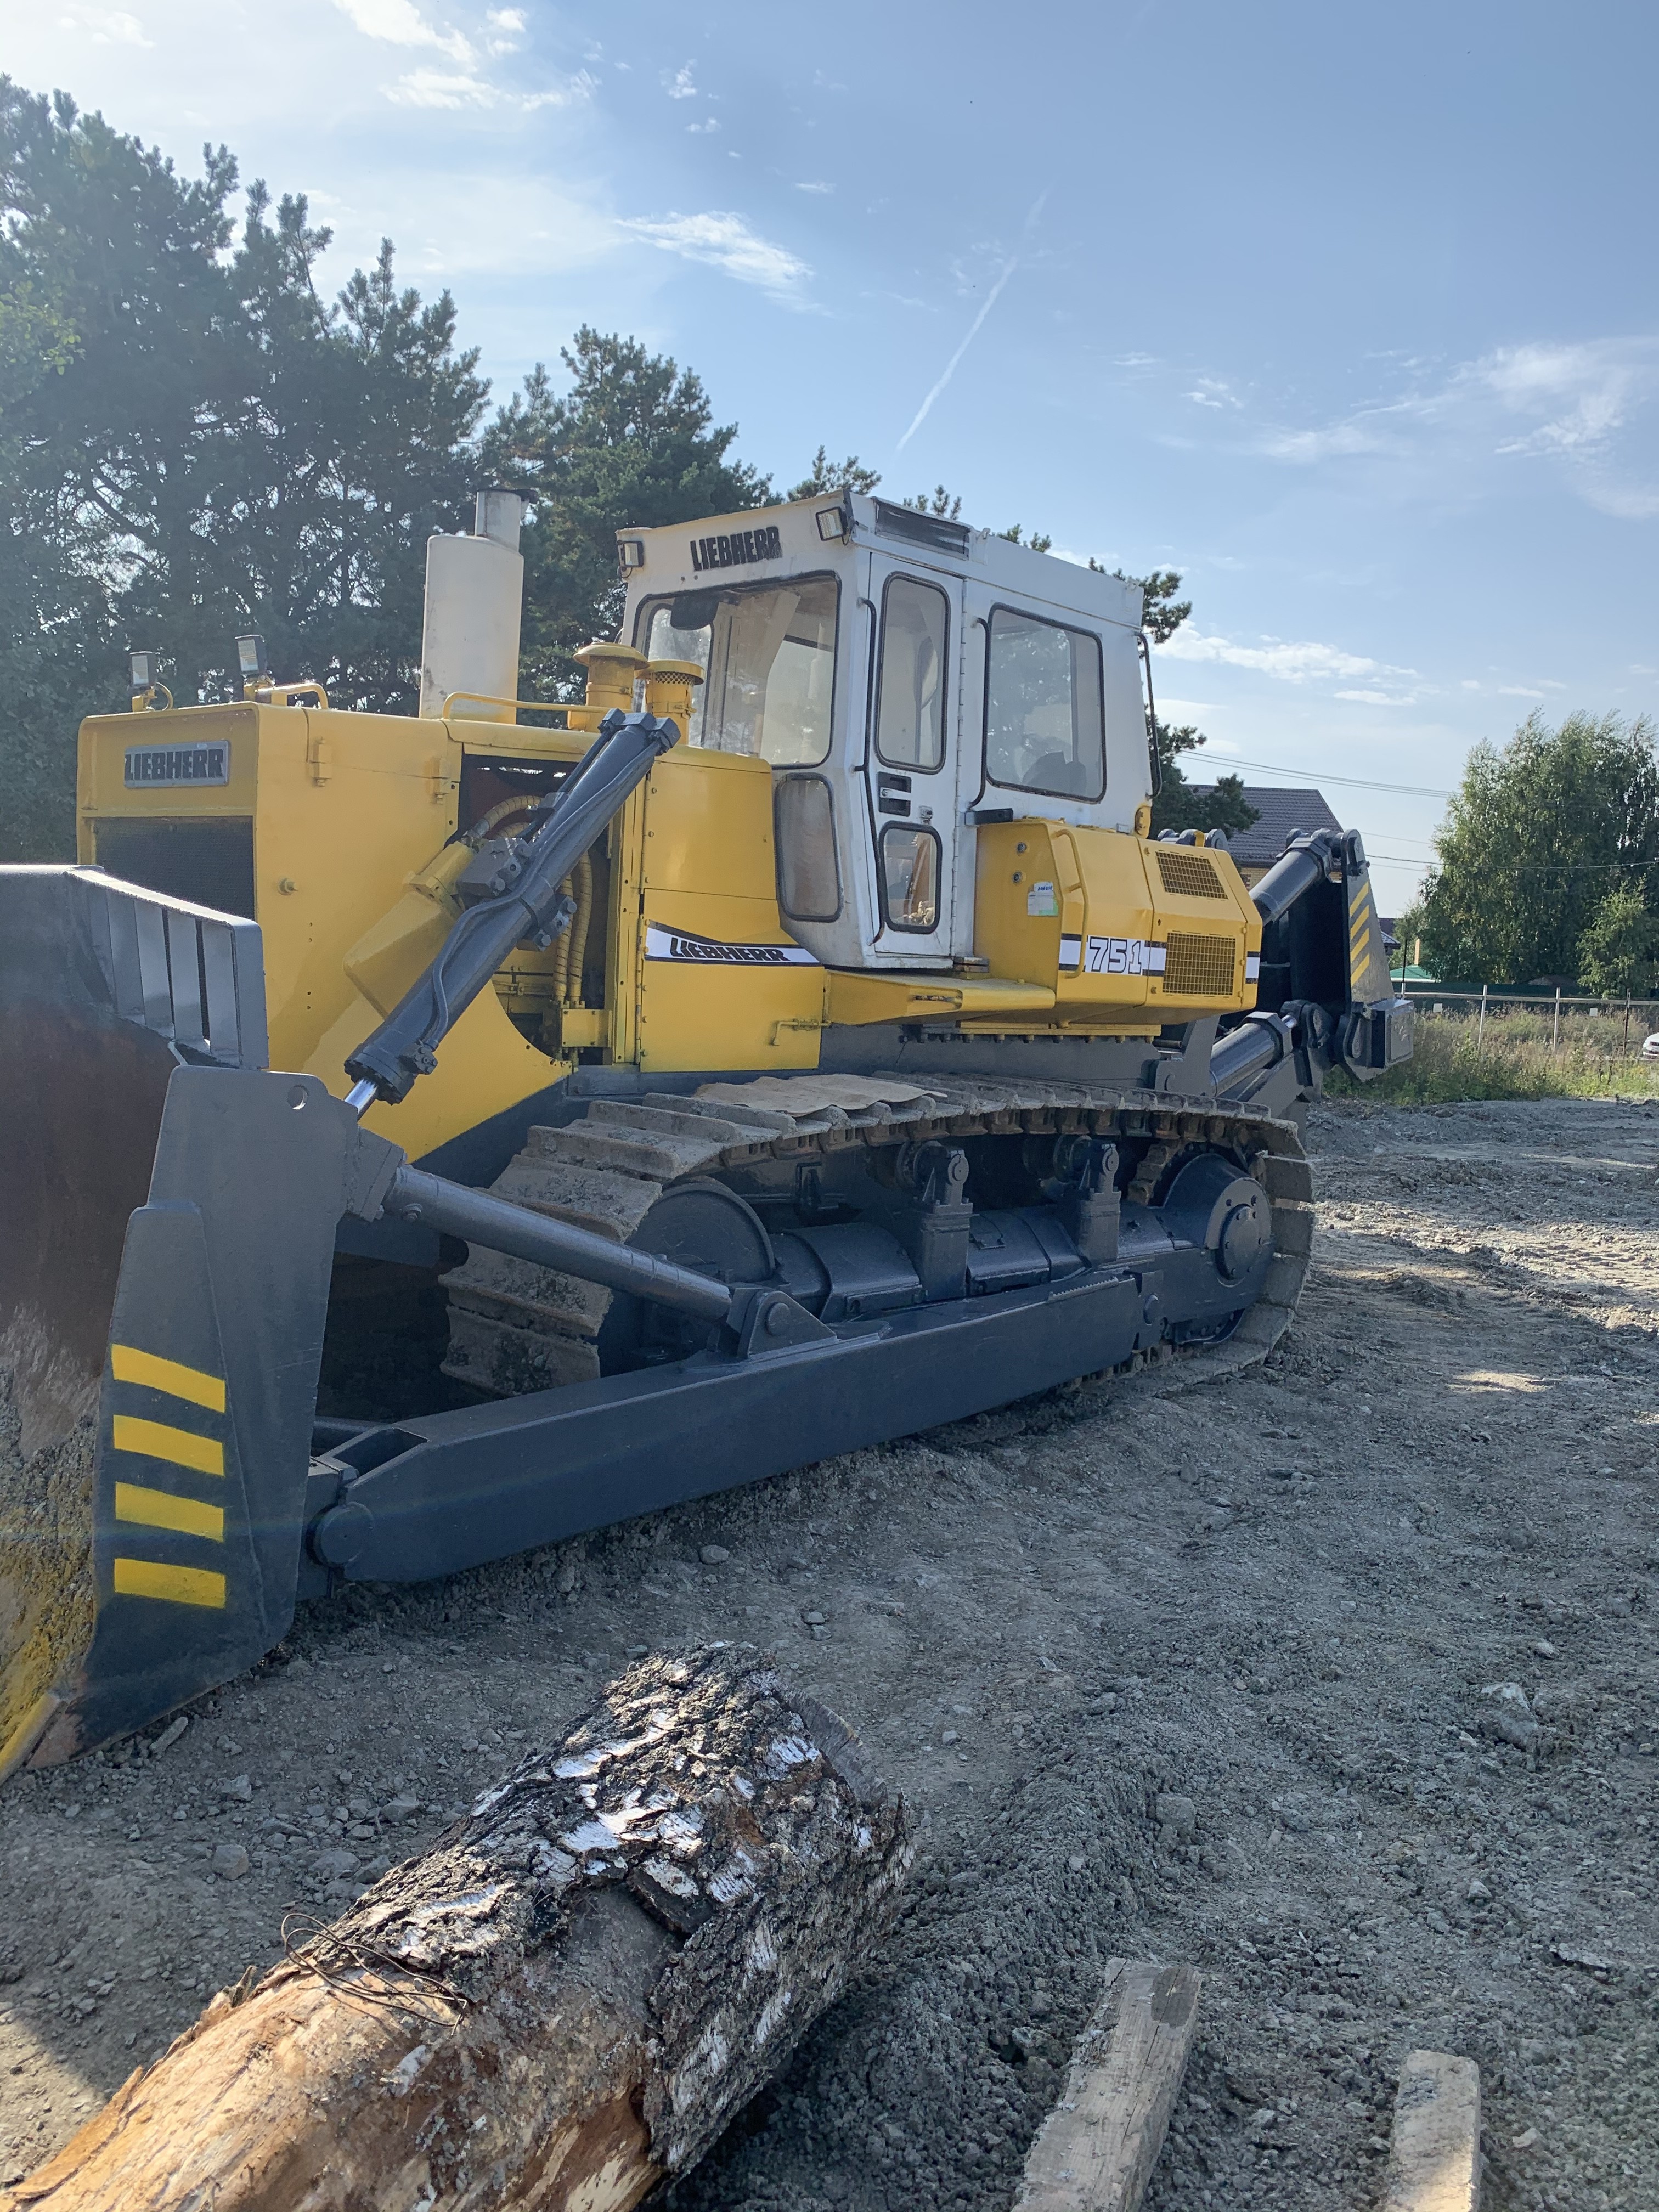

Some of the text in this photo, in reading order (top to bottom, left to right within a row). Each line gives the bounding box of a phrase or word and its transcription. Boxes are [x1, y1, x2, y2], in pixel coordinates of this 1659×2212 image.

[690, 526, 782, 571] LIEBHERR
[125, 749, 224, 780] LIEBHERR
[670, 937, 790, 962] LIEBHERR
[1089, 935, 1142, 975] 751
